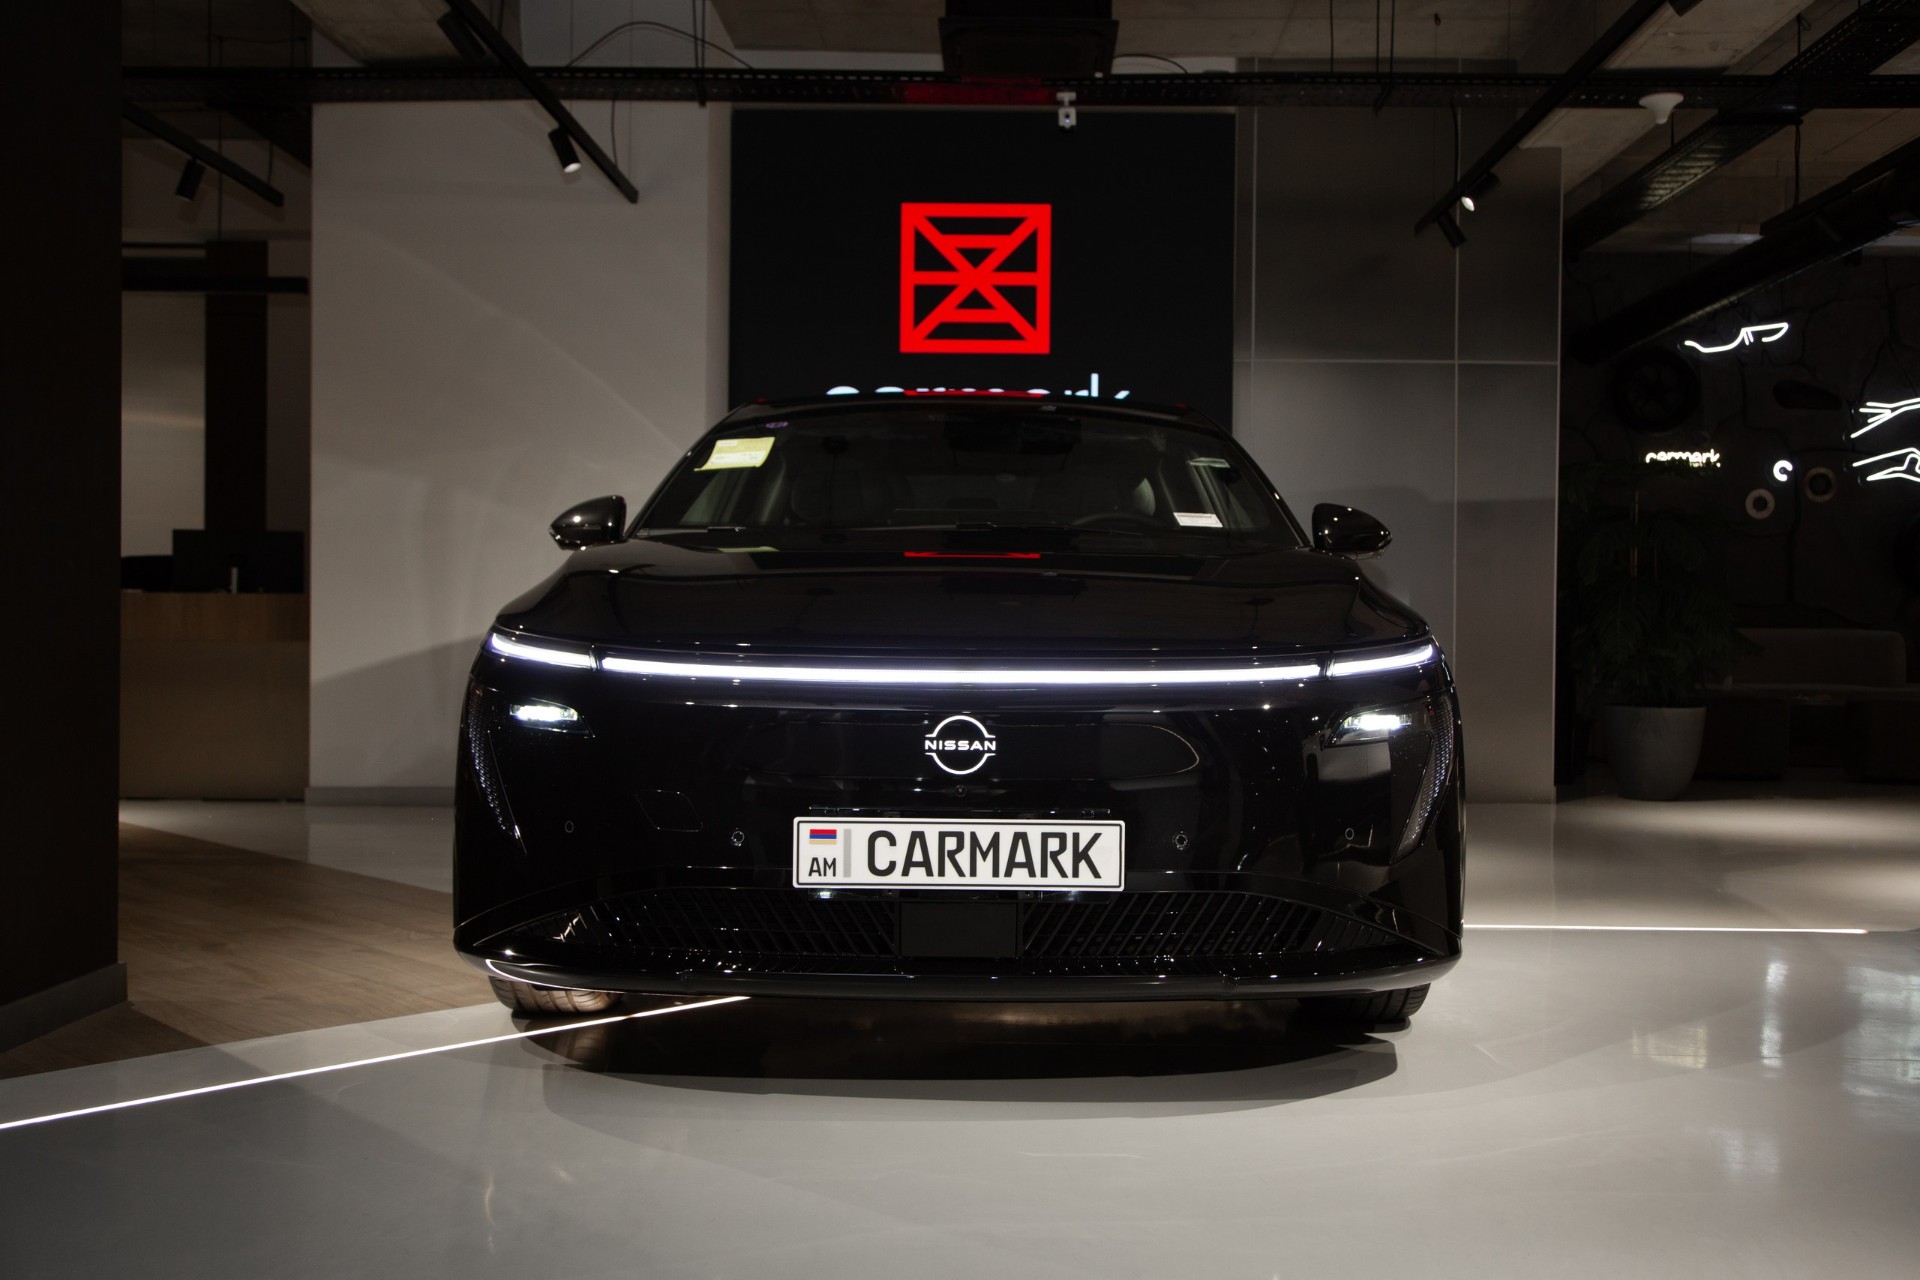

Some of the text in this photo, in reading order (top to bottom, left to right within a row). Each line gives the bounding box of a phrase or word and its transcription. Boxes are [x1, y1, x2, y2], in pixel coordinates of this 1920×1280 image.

[924, 739, 997, 751] NISSAN
[867, 830, 1103, 879] CARMARK
[808, 856, 837, 877] AM
